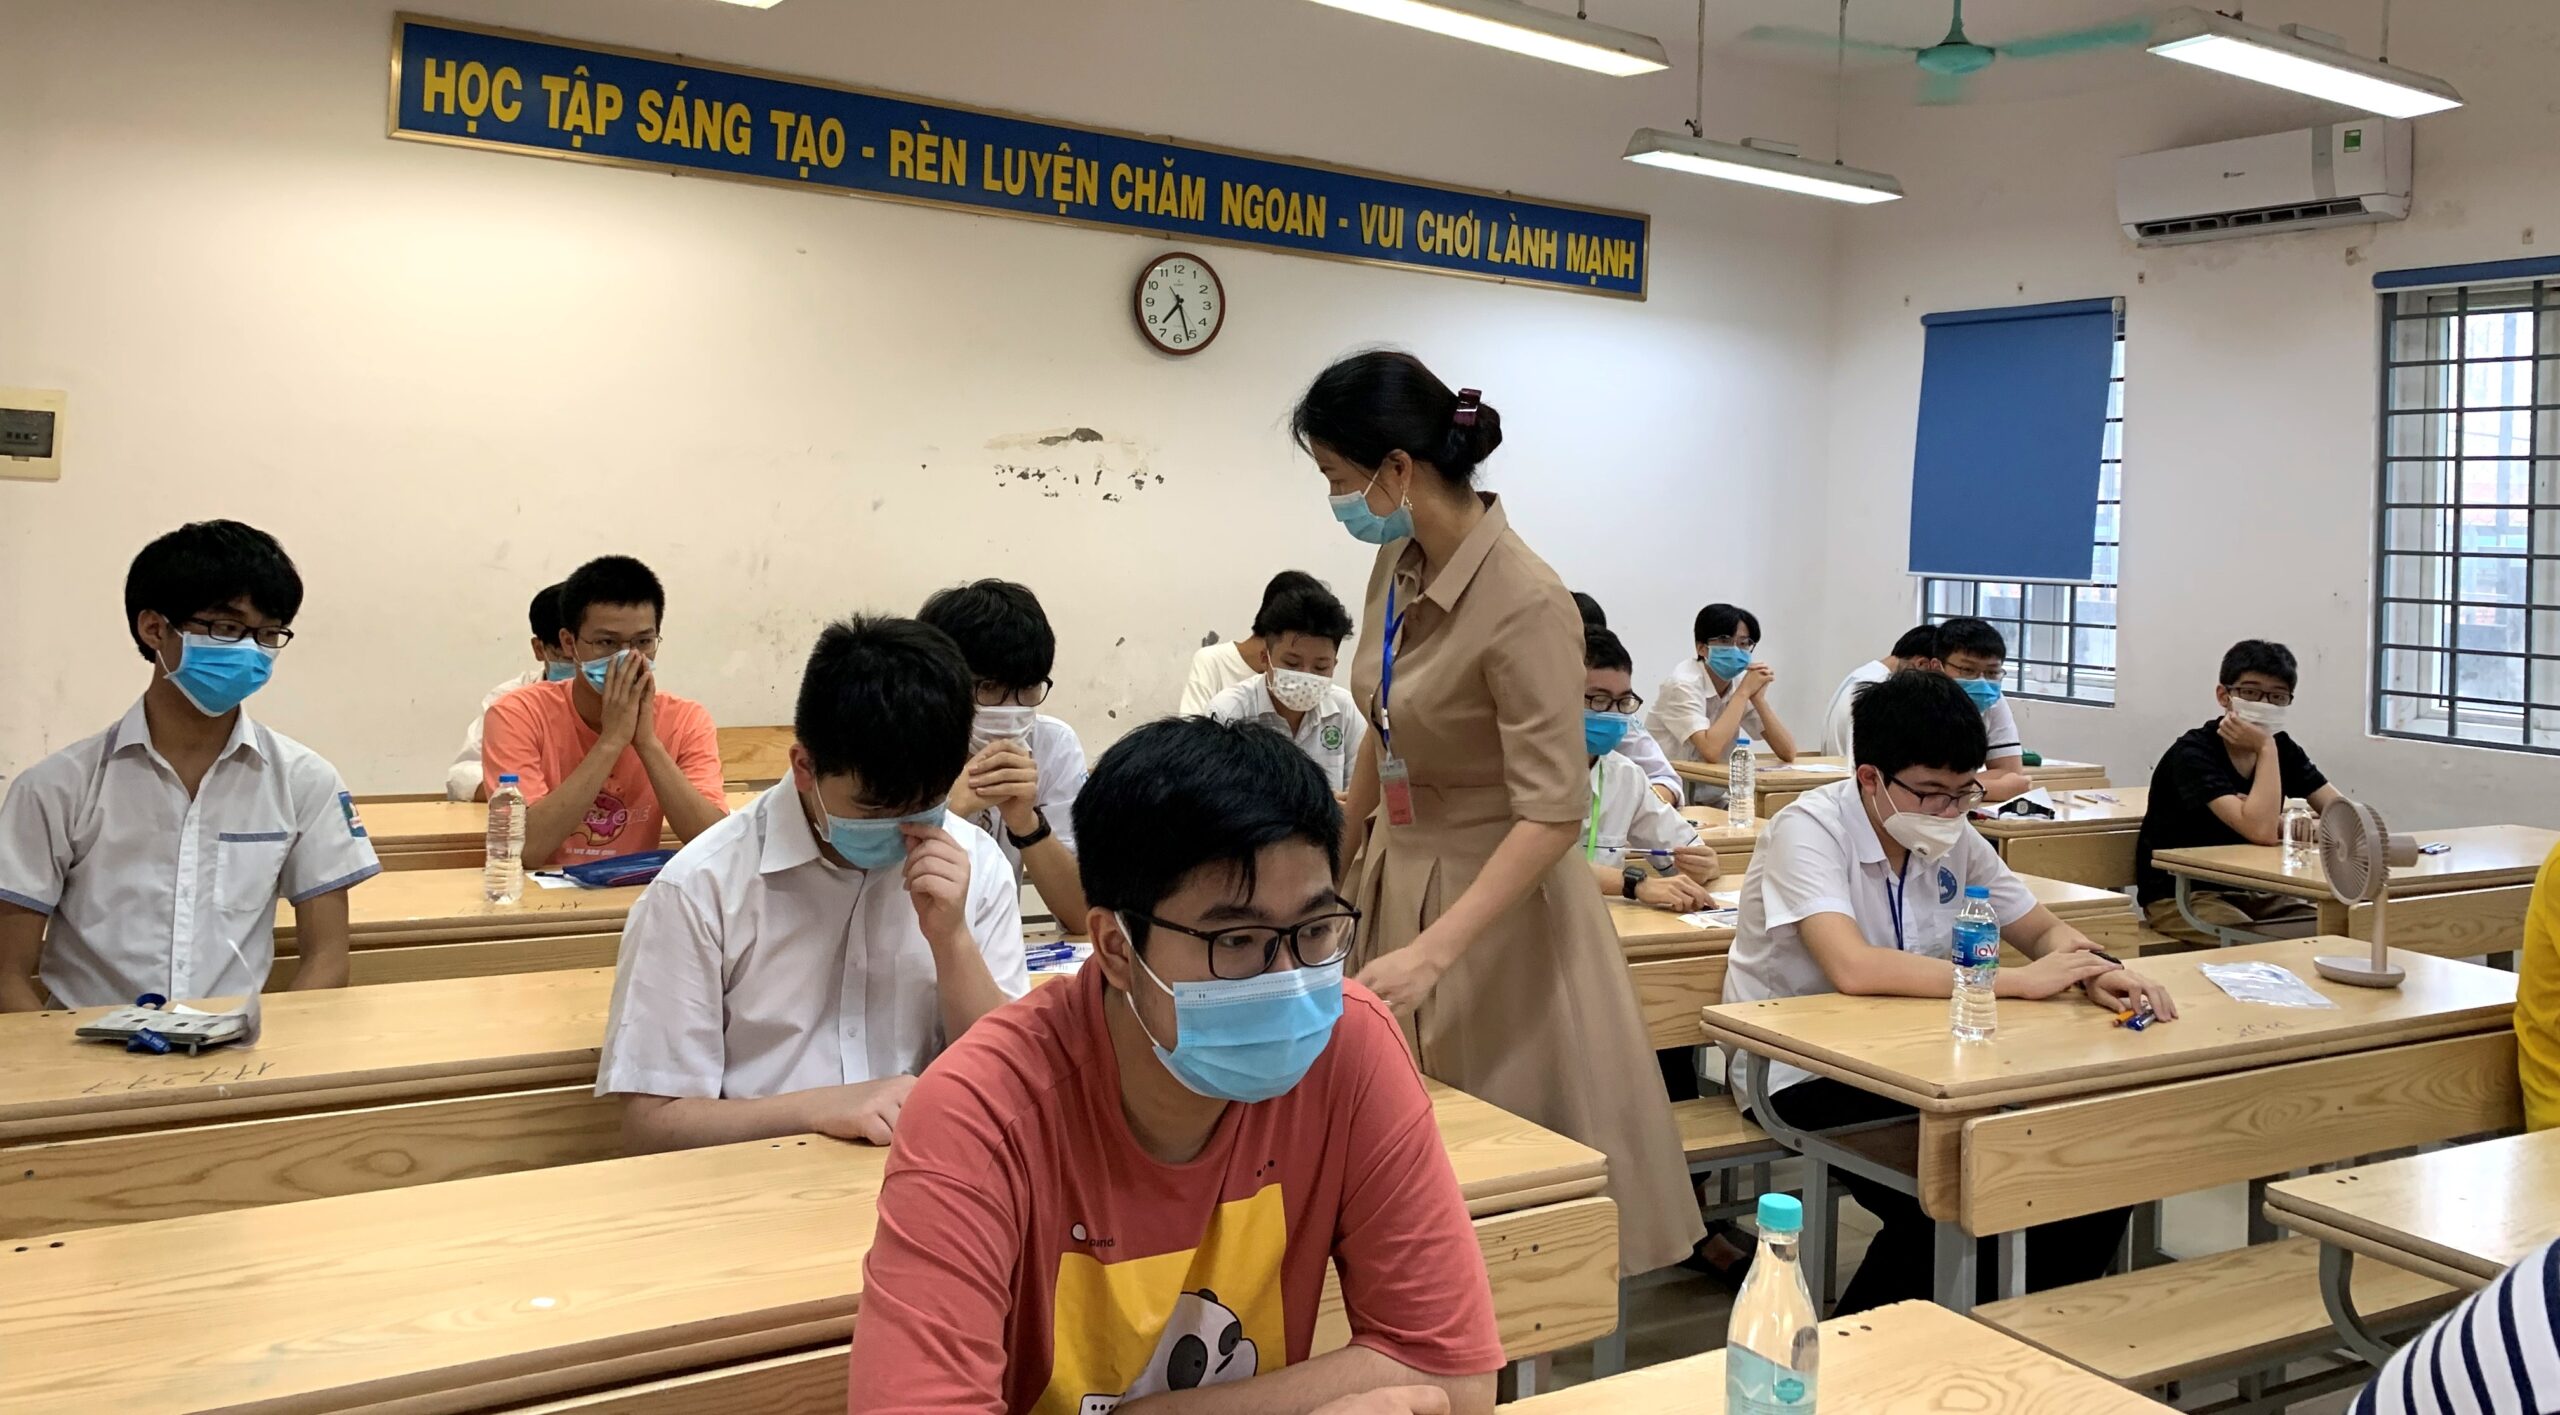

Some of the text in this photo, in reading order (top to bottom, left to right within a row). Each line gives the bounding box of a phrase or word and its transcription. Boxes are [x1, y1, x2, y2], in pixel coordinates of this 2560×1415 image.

[424, 58, 522, 133] HỌC
[542, 66, 623, 147] TẬP
[637, 81, 751, 156] SÁNG
[771, 111, 846, 178] TẠO
[863, 146, 874, 158] -
[890, 119, 967, 187] RÈN
[984, 143, 1099, 213] LUYỆN
[1111, 157, 1206, 221] CHĂM
[1222, 182, 1327, 239] NGOAN
[1360, 203, 1404, 250] VUI
[1418, 210, 1481, 260] CHƠI
[1487, 212, 1558, 270] LÀNH
[1567, 232, 1636, 286] MẠNH
[1160, 269, 1168, 277] 11
[1174, 265, 1184, 274] 12
[1148, 281, 1158, 290] 10
[1199, 285, 1208, 294] 2
[1145, 297, 1154, 307] 9
[1203, 301, 1212, 310] 3
[1148, 315, 1157, 324] 8
[1198, 318, 1206, 326] 4
[1159, 328, 1167, 337] 7
[1188, 330, 1197, 339] 5
[1173, 334, 1182, 343] 6
